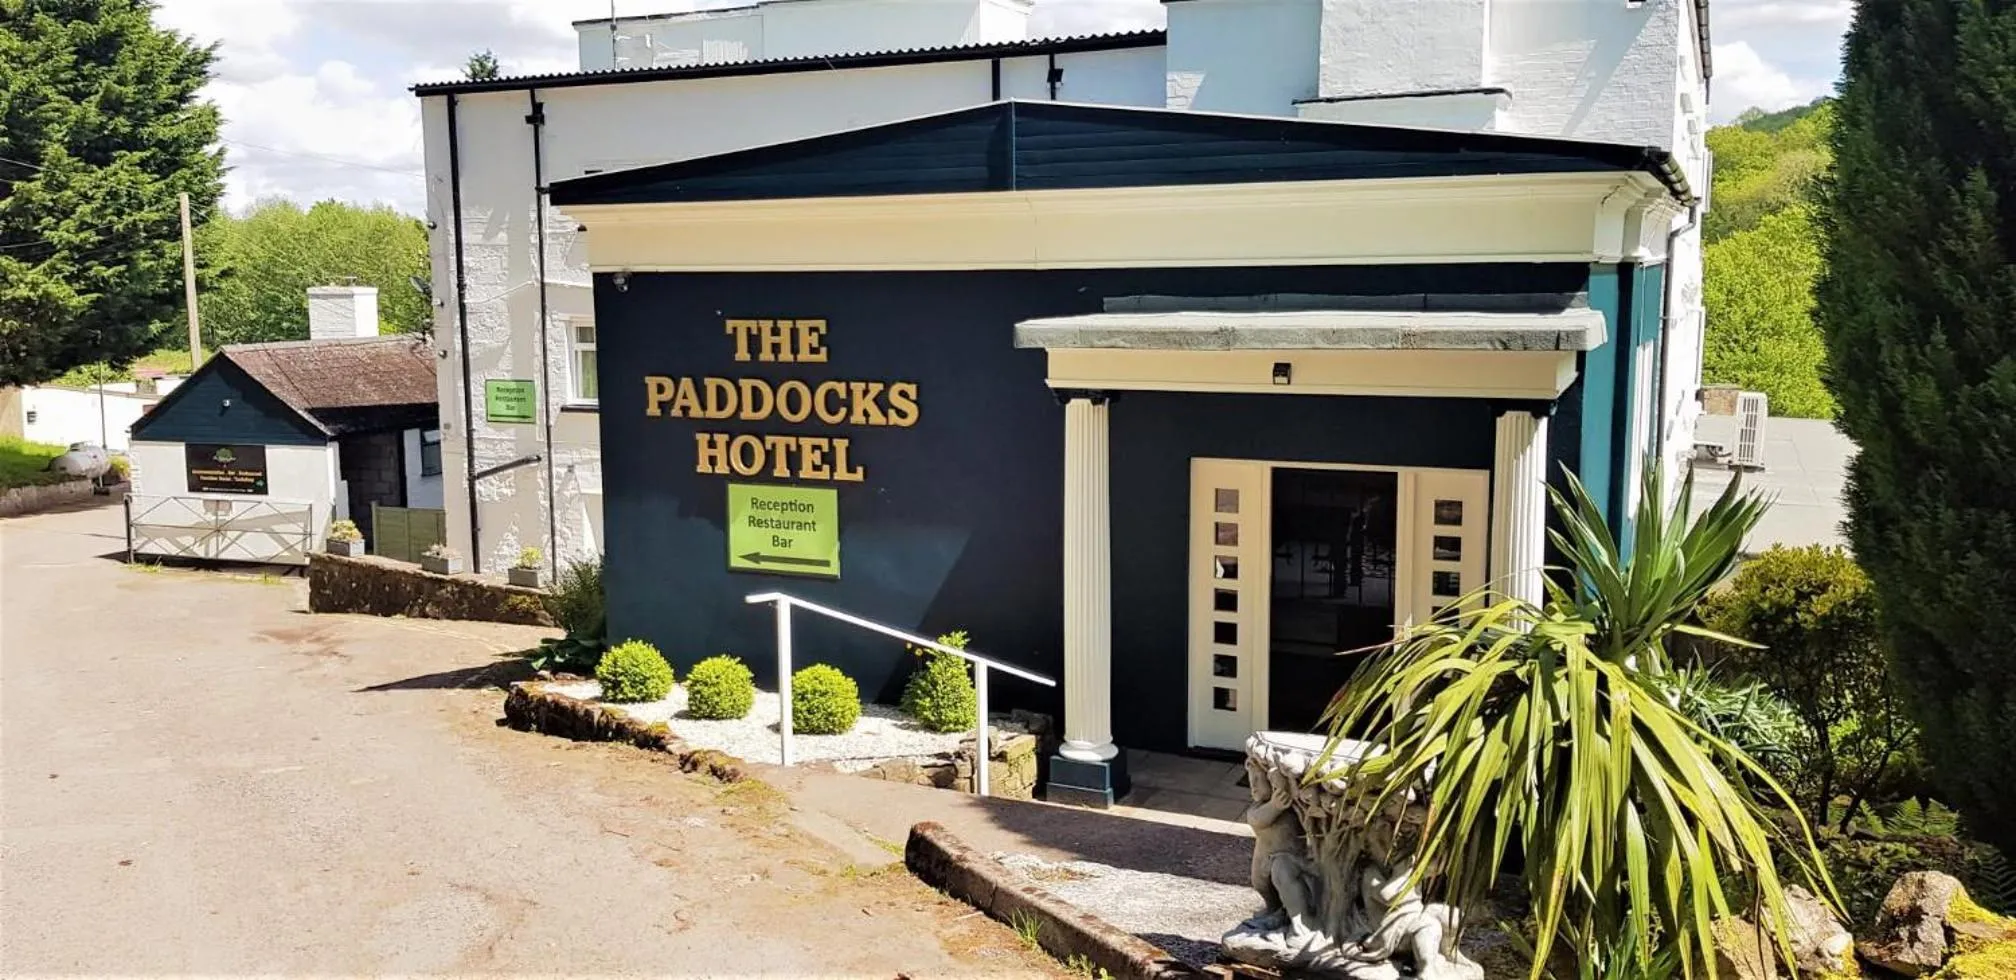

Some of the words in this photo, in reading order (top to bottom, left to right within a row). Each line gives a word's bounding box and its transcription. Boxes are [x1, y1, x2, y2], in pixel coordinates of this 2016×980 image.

[725, 319, 829, 362] THE
[644, 375, 920, 427] PADDOCKS
[695, 432, 865, 482] HOTEL
[750, 497, 815, 514] Reception
[747, 515, 817, 532] Restaurant
[771, 535, 794, 549] Bar
